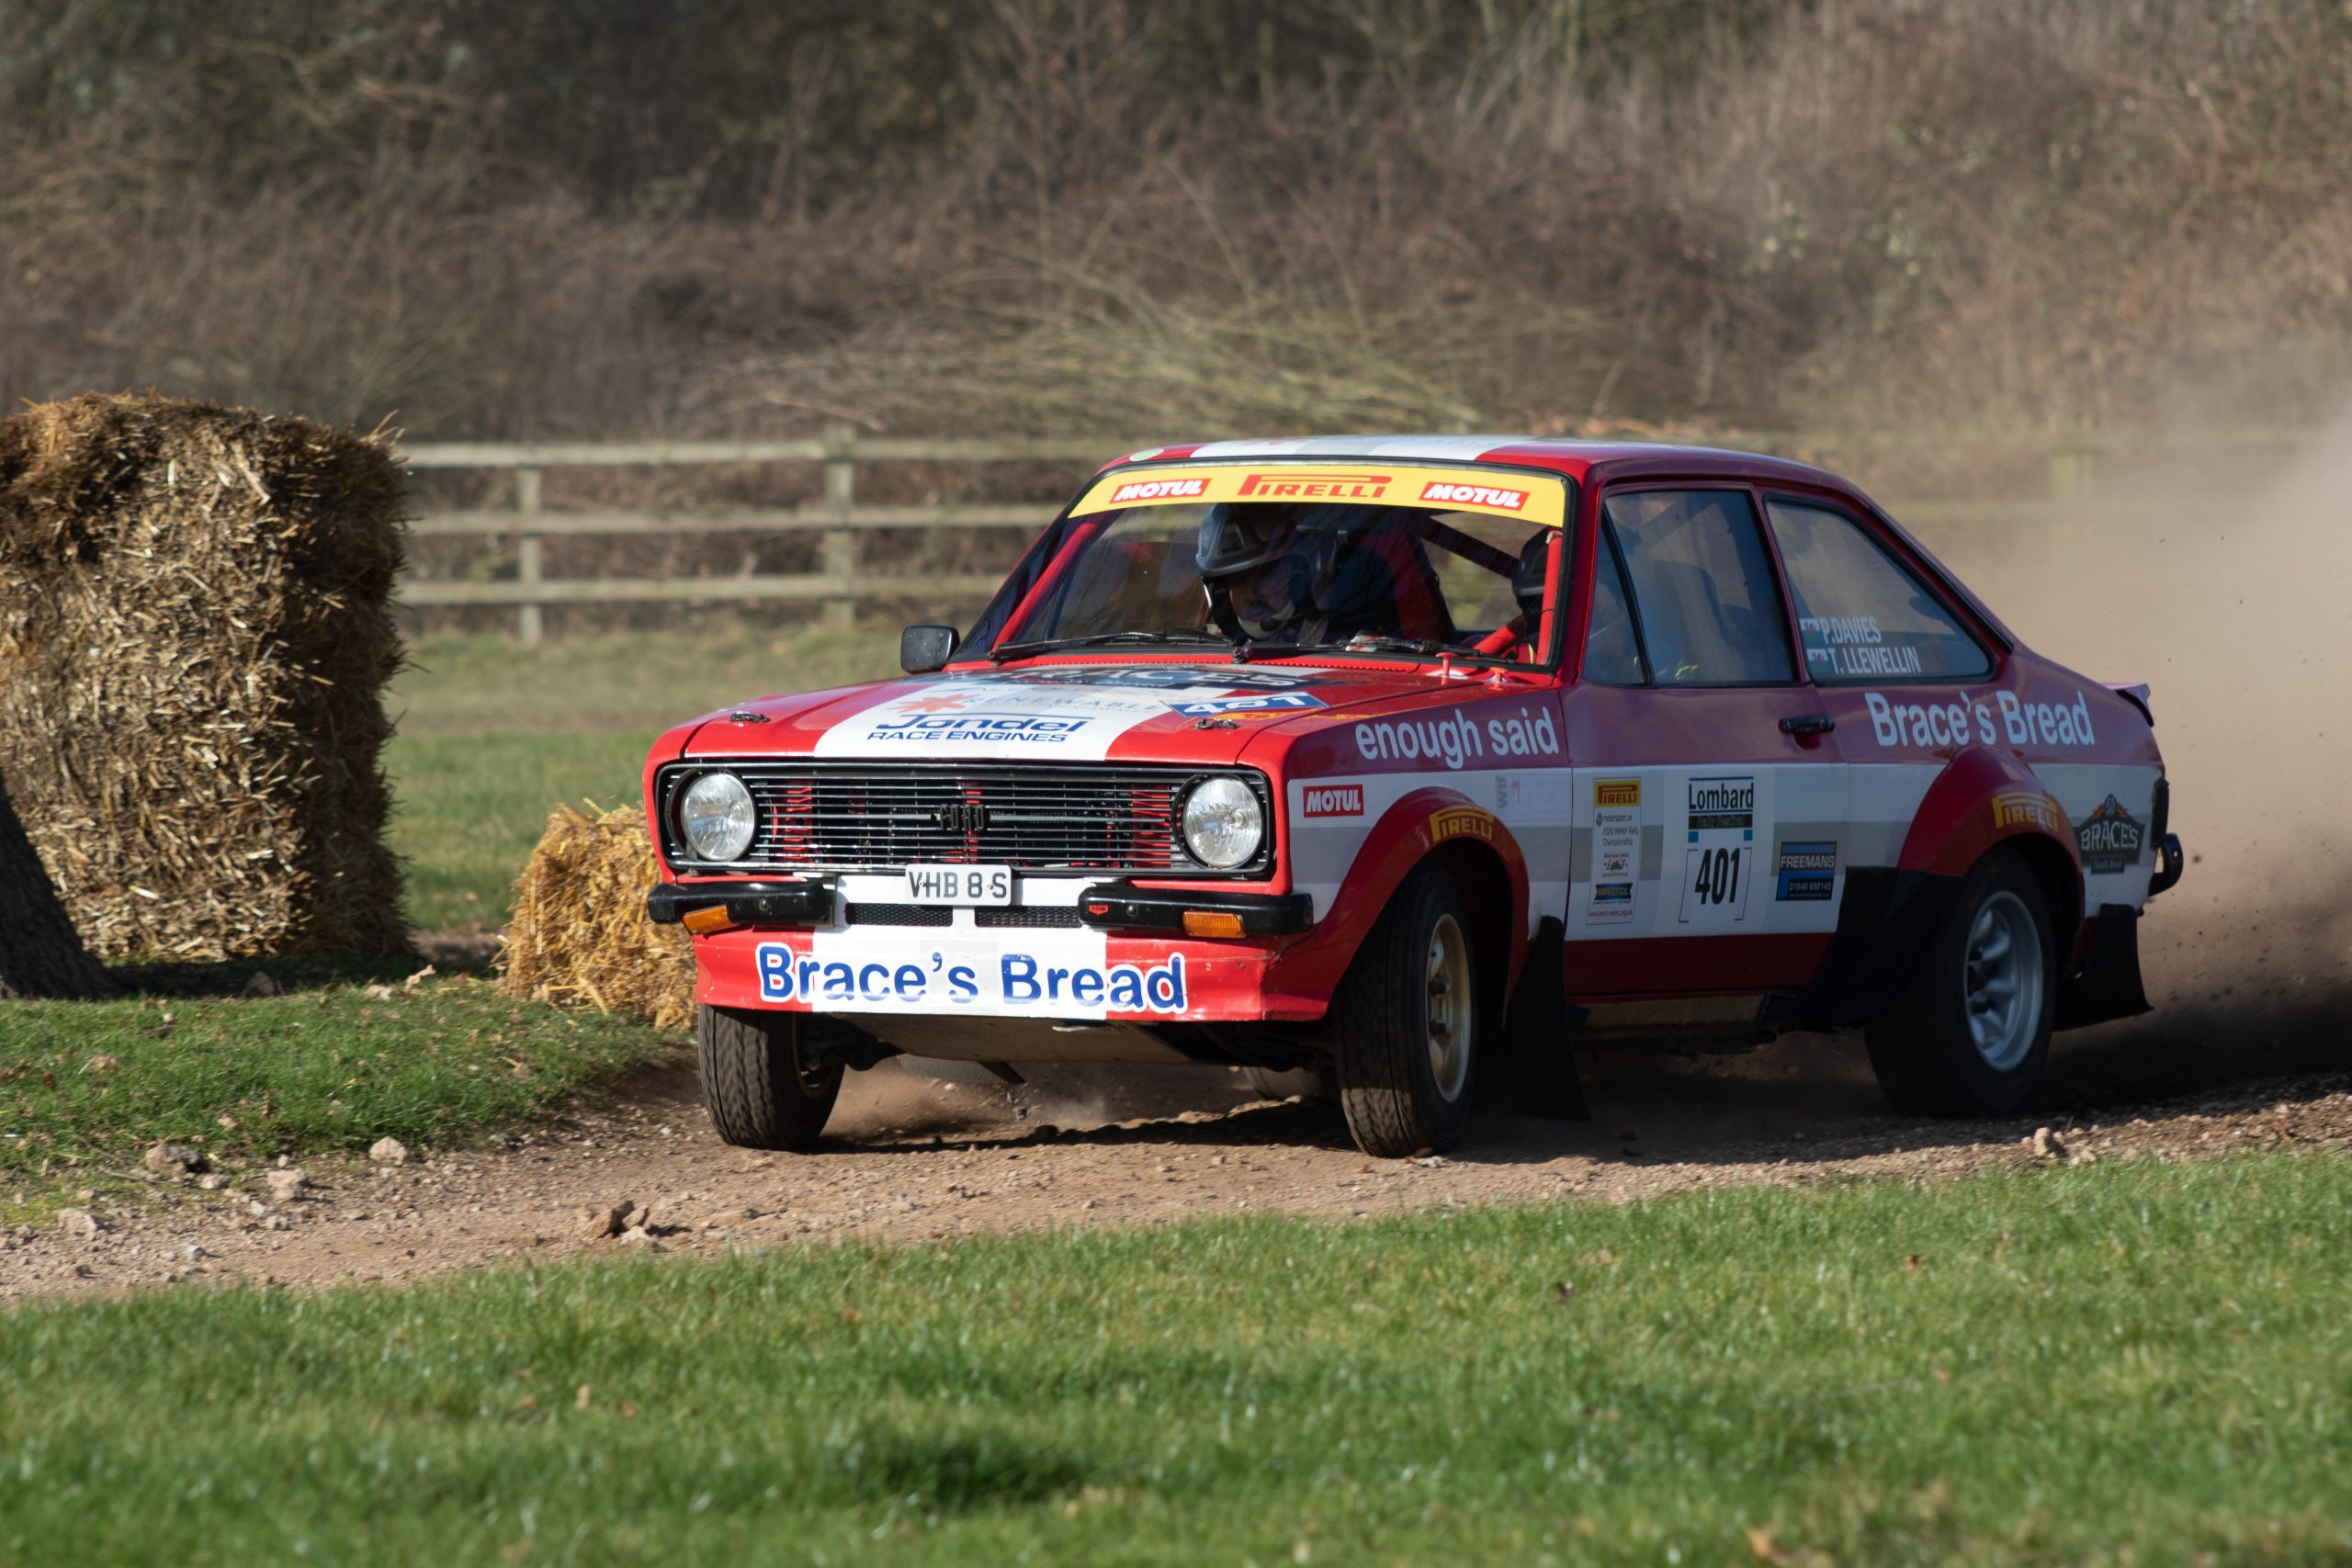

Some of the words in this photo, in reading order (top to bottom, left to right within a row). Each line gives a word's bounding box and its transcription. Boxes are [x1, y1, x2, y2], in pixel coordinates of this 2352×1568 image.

[1114, 479, 1204, 502] MOTUL
[1238, 474, 1392, 498] PIRELLI
[1424, 484, 1521, 508] MOTUL
[1828, 648, 1844, 674] T.
[1842, 646, 1922, 674] LLEWELLIN
[1183, 695, 1306, 713] 401
[876, 713, 1095, 732] Jondel
[1865, 690, 1996, 747] Brace's
[1996, 690, 2095, 746] Bread
[867, 730, 943, 741] RACE
[945, 731, 1069, 742] ENGINES
[1355, 708, 1483, 770] enough
[1487, 706, 1559, 756] said
[1306, 789, 1362, 813] MOTUL
[1597, 784, 1638, 804] PIRELLI
[1689, 783, 1754, 810] Lombard
[1429, 805, 1495, 842] PIRELLI
[1602, 814, 1626, 824] motorsport
[1991, 792, 2058, 831] PIRELLI
[1602, 827, 1614, 836] 2020
[1602, 837, 1634, 847] Championship
[2080, 821, 2139, 851] BRACE'S
[1781, 855, 1836, 869] FREEMANS
[909, 872, 959, 898] VHB
[967, 872, 983, 898] 8
[991, 873, 1007, 898] S
[1694, 848, 1741, 905] 401
[759, 945, 979, 1005] Brace's
[1001, 953, 1185, 1010] Bread
